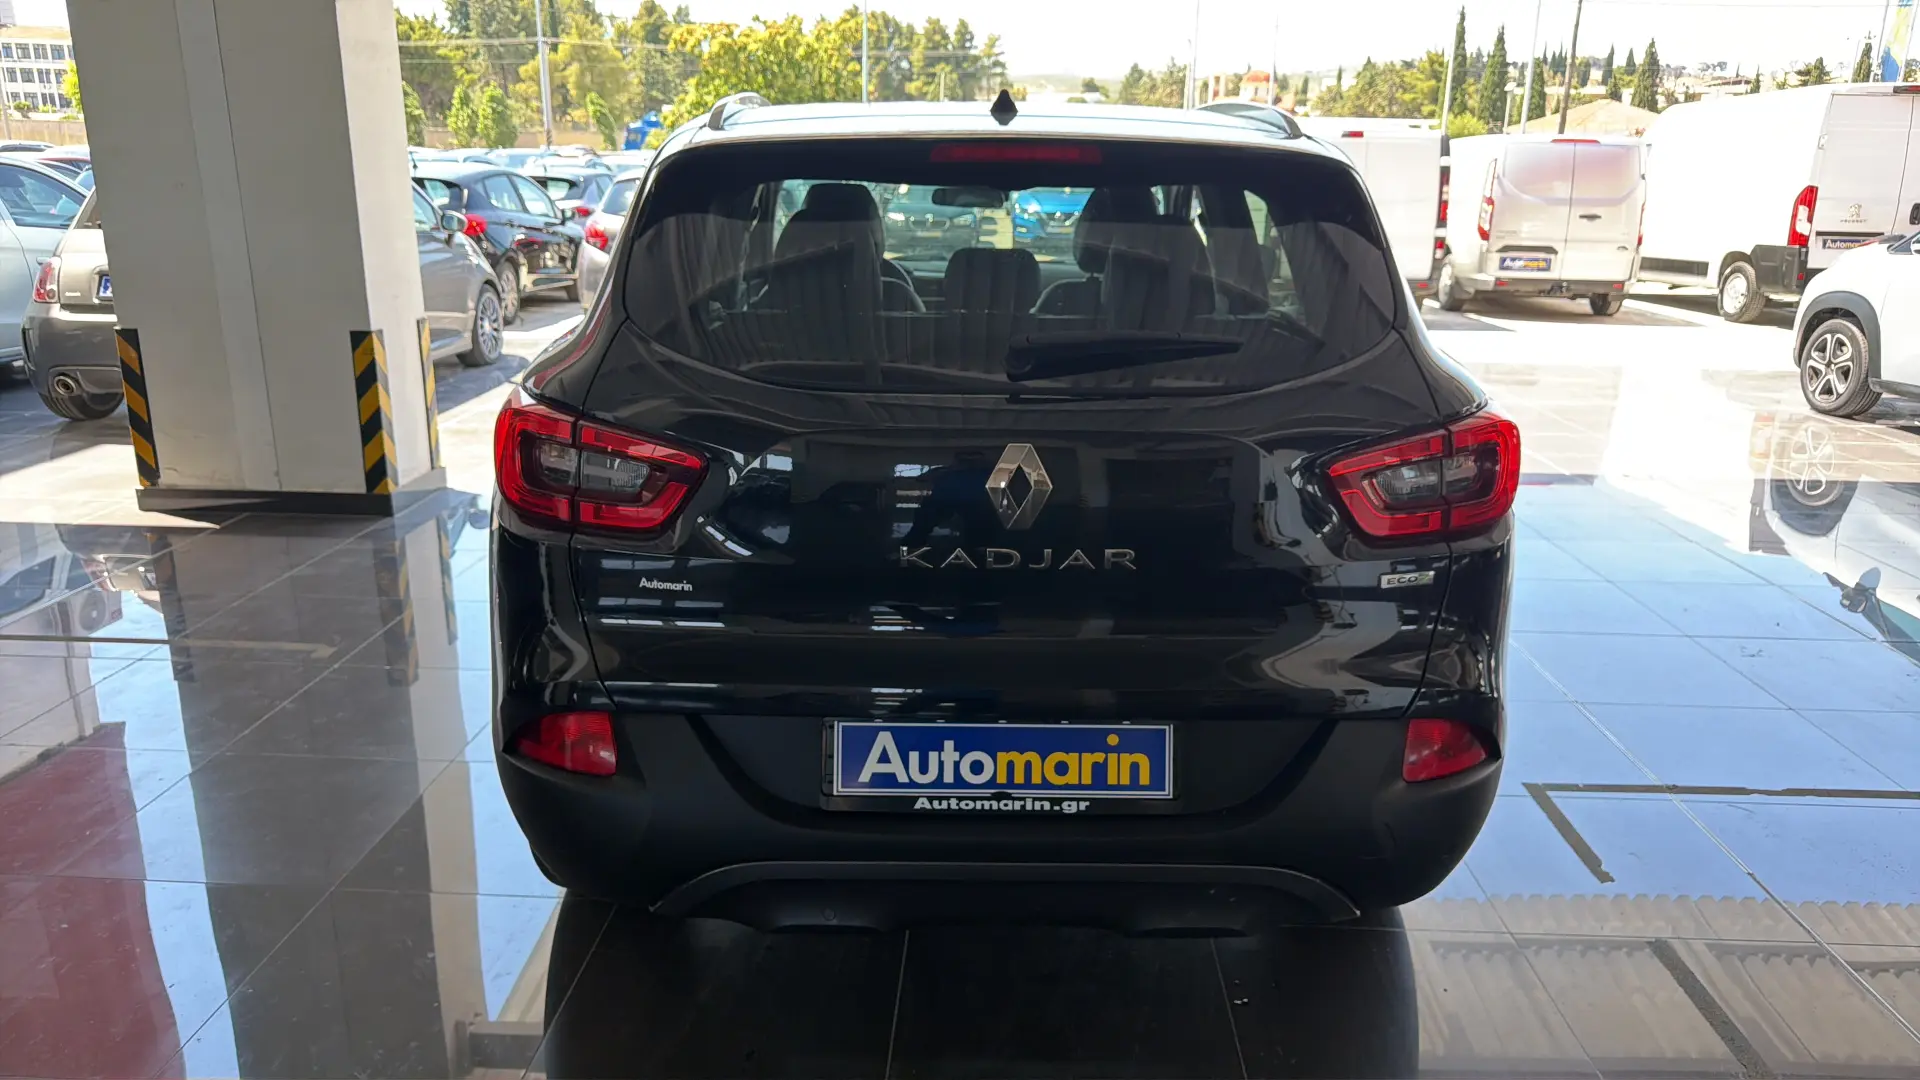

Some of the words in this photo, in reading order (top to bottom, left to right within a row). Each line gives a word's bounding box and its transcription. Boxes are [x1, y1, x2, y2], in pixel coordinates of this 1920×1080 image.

[900, 546, 1137, 570] KADJAR
[639, 577, 693, 591] Automarin
[858, 730, 1150, 785] Automarin
[914, 797, 1090, 813] Automarin.gr
